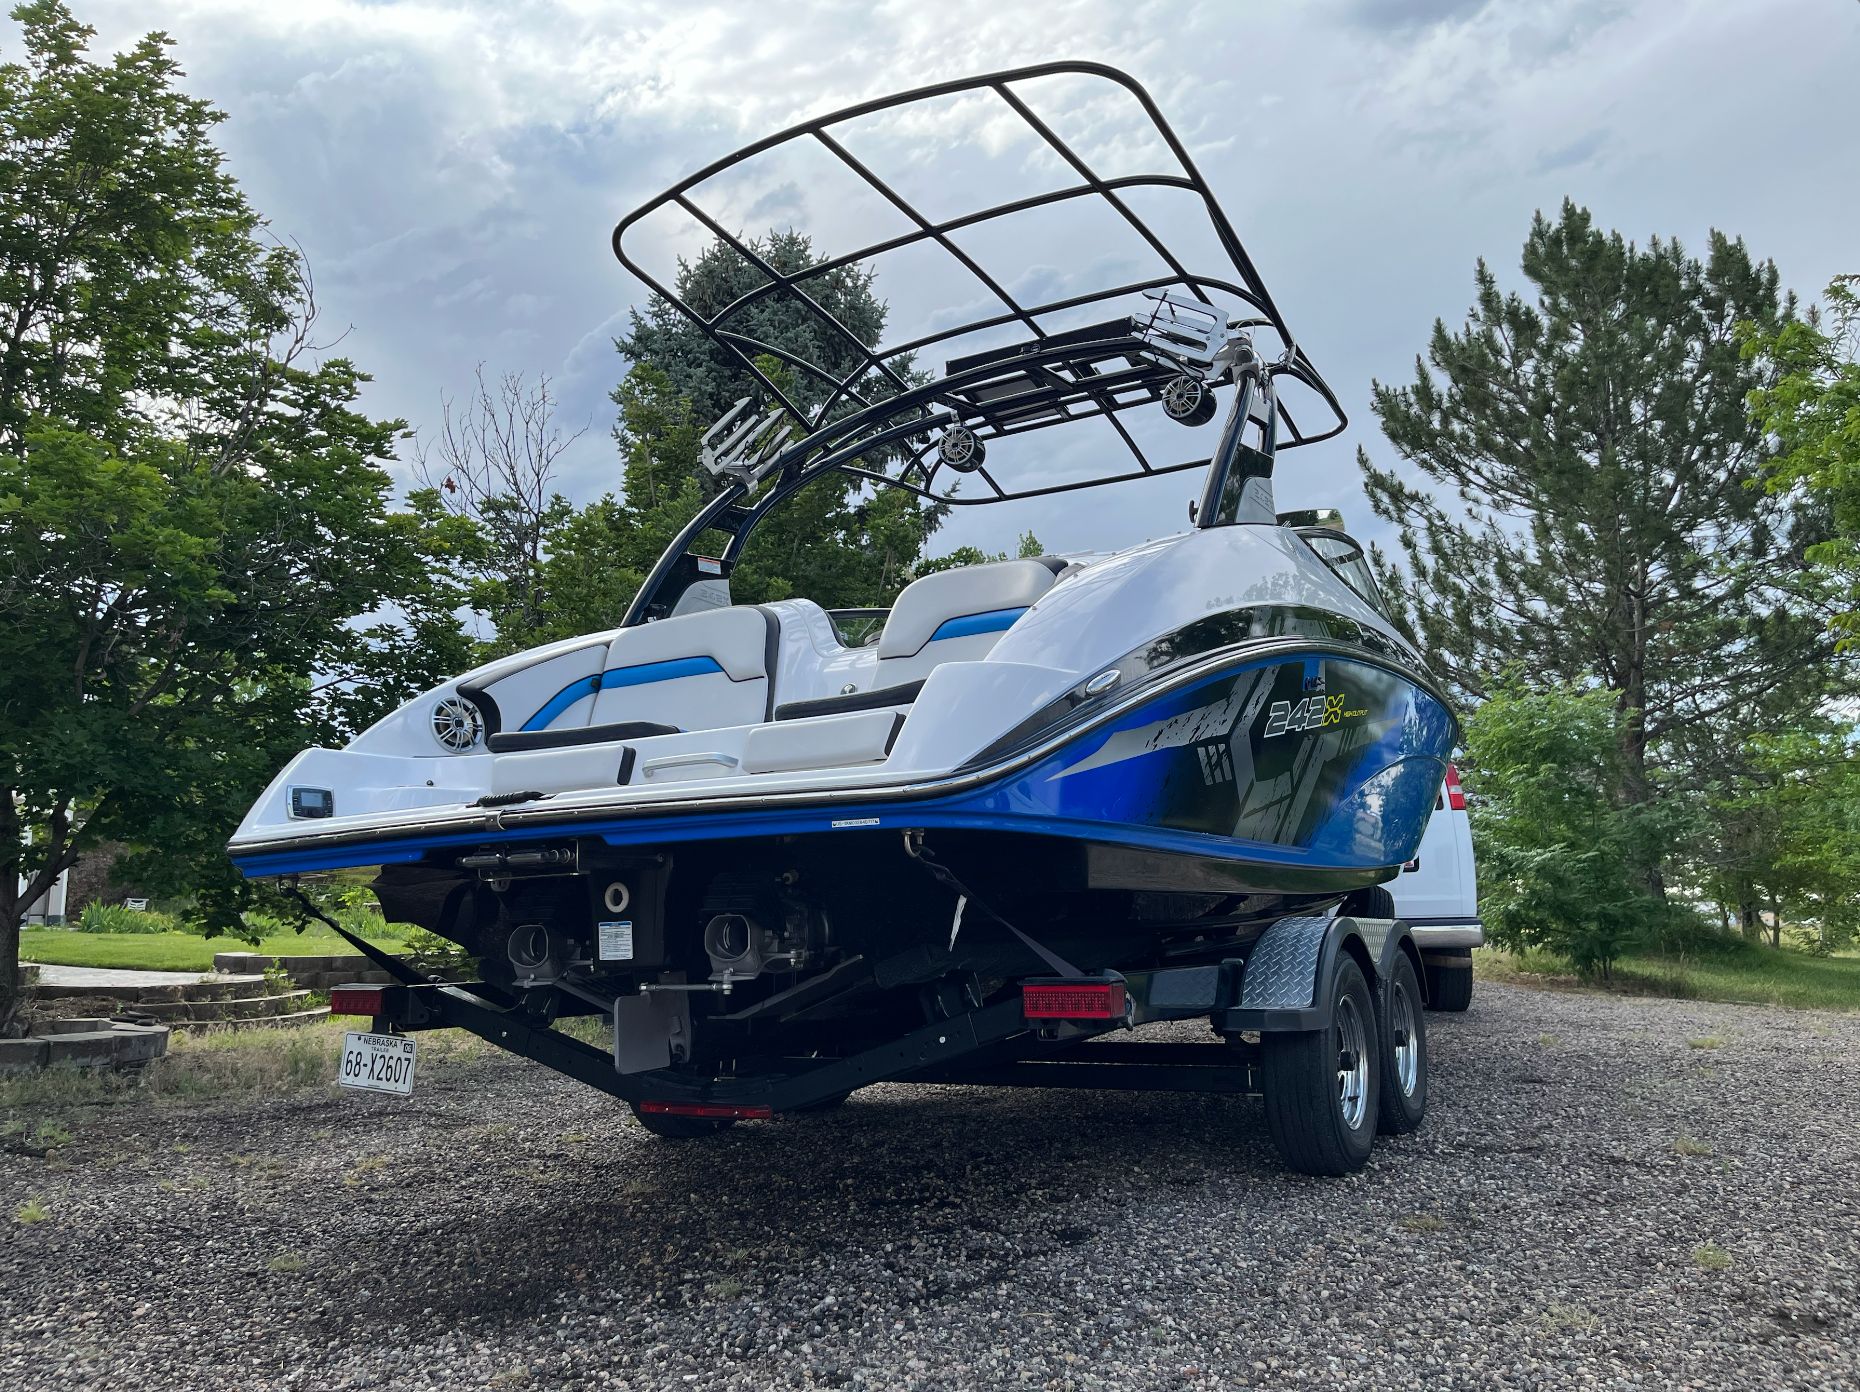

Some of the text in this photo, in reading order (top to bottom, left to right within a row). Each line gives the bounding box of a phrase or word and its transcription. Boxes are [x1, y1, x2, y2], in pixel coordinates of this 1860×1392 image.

[1264, 694, 1345, 738] 242X
[363, 1036, 398, 1048] NEBRASKA
[345, 1050, 412, 1085] 68-X2607
